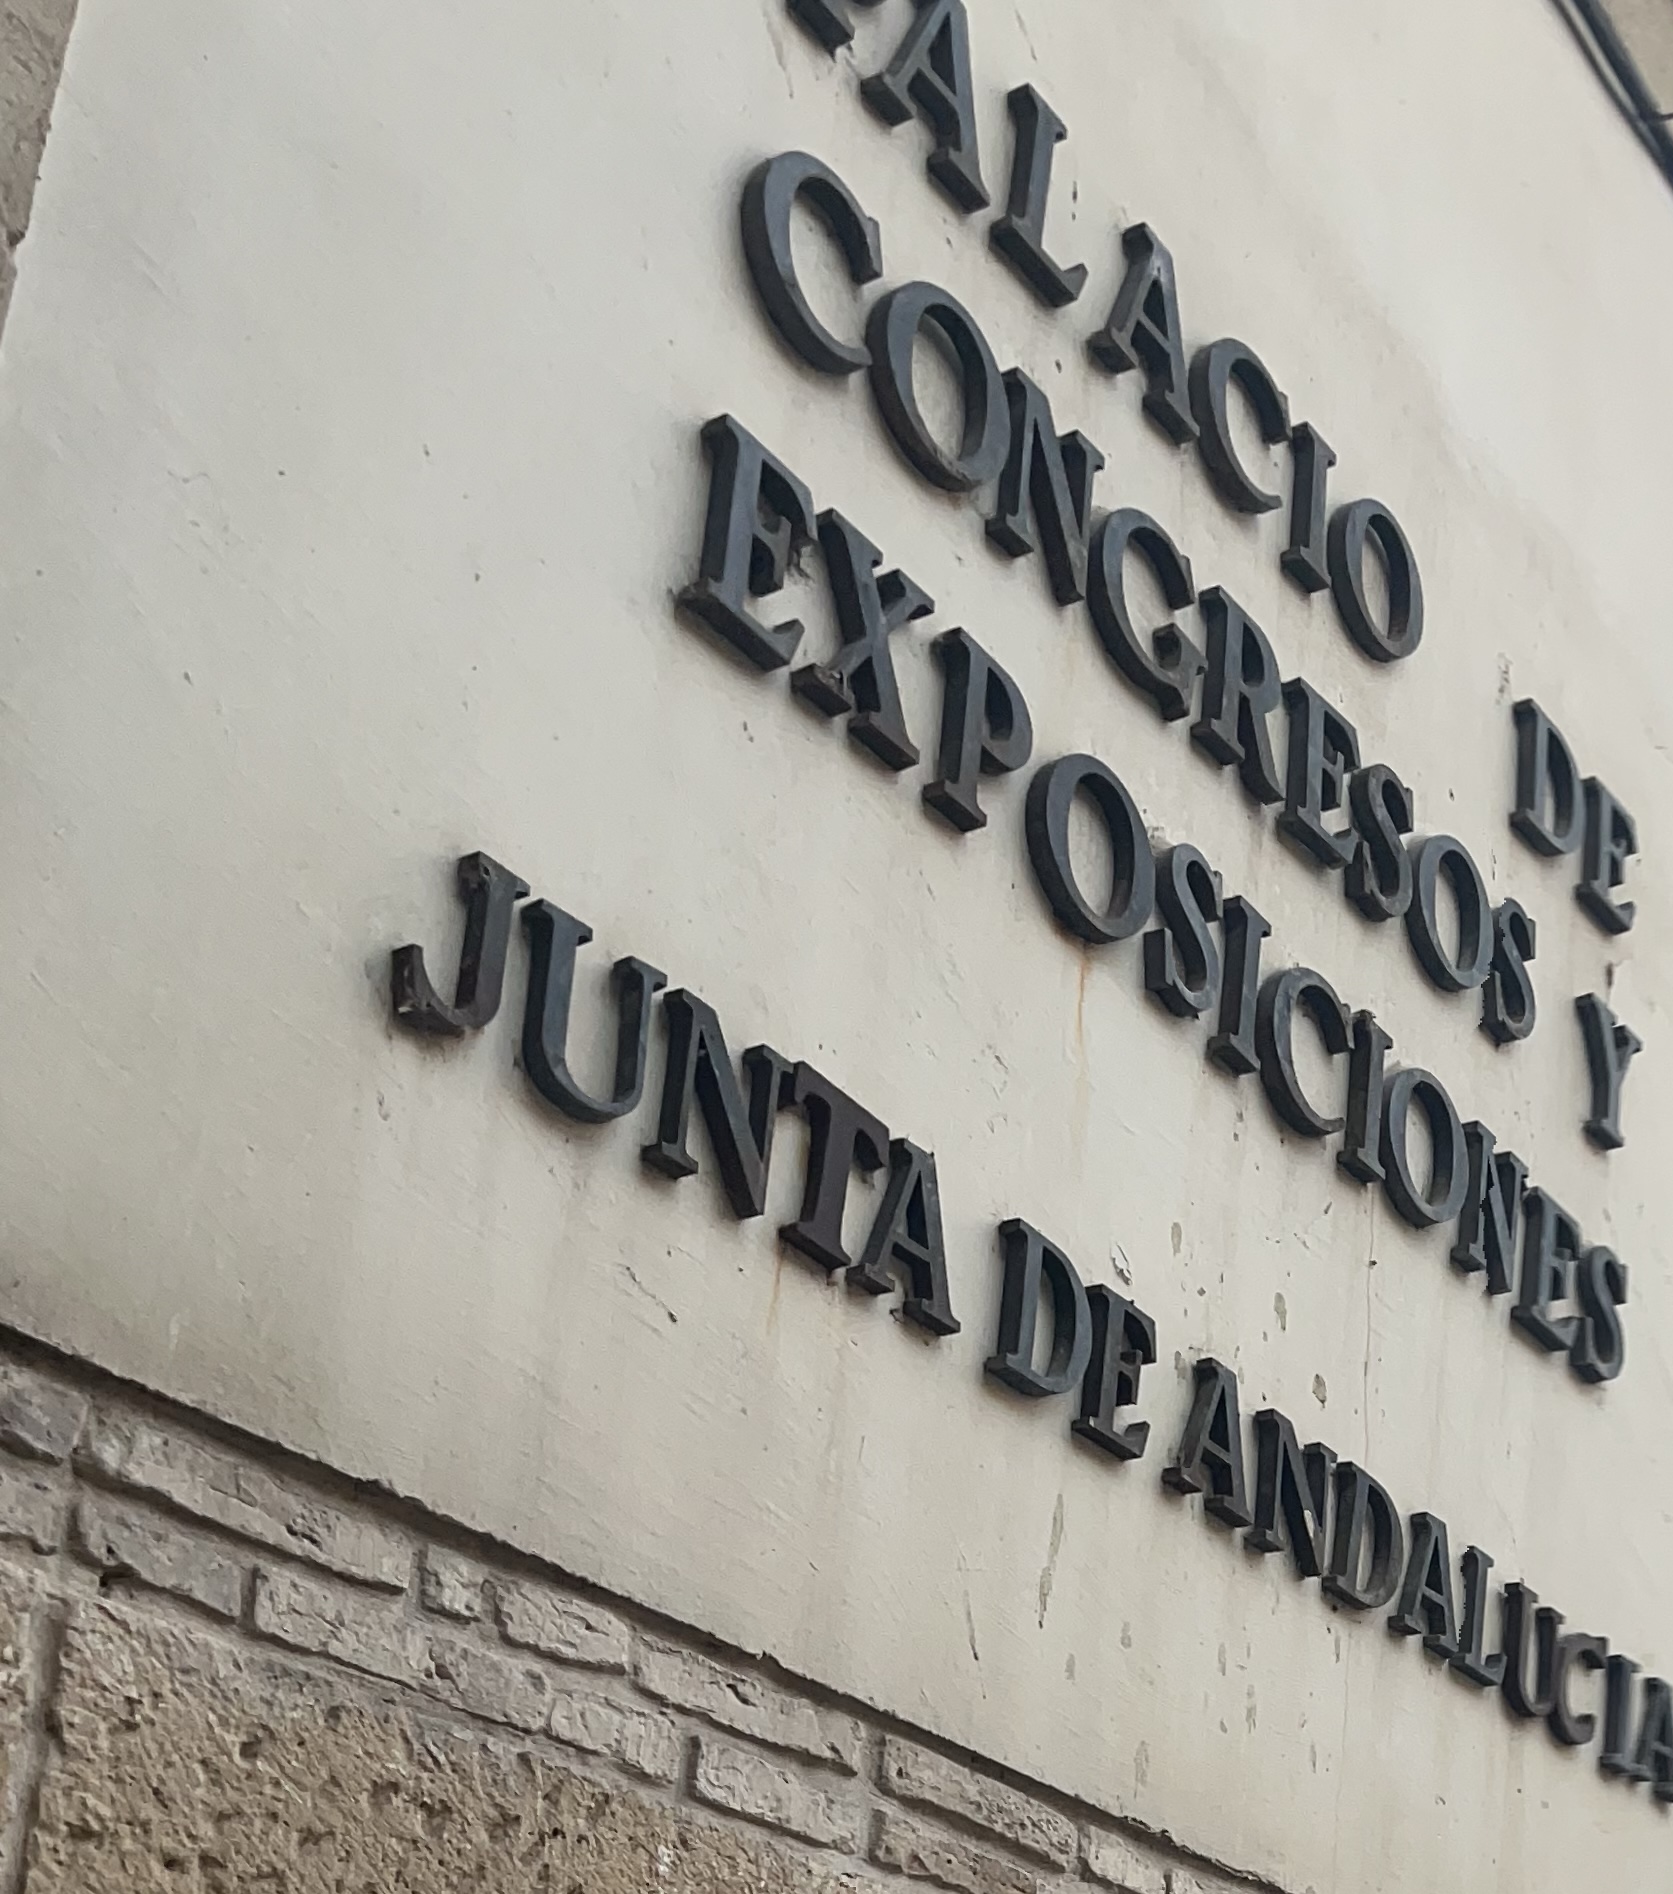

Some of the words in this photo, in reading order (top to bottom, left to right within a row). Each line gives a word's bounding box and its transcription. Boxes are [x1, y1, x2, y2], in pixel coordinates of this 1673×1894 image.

[672, 413, 1628, 1384] EXPOSICIONES
[741, 150, 1538, 1046] CONGRESOS
[1576, 993, 1642, 1150] Y
[785, 0, 1424, 663] ALACIO
[1512, 698, 1640, 935] DE
[392, 850, 961, 1337] JUNTA
[984, 1219, 1157, 1460] DE
